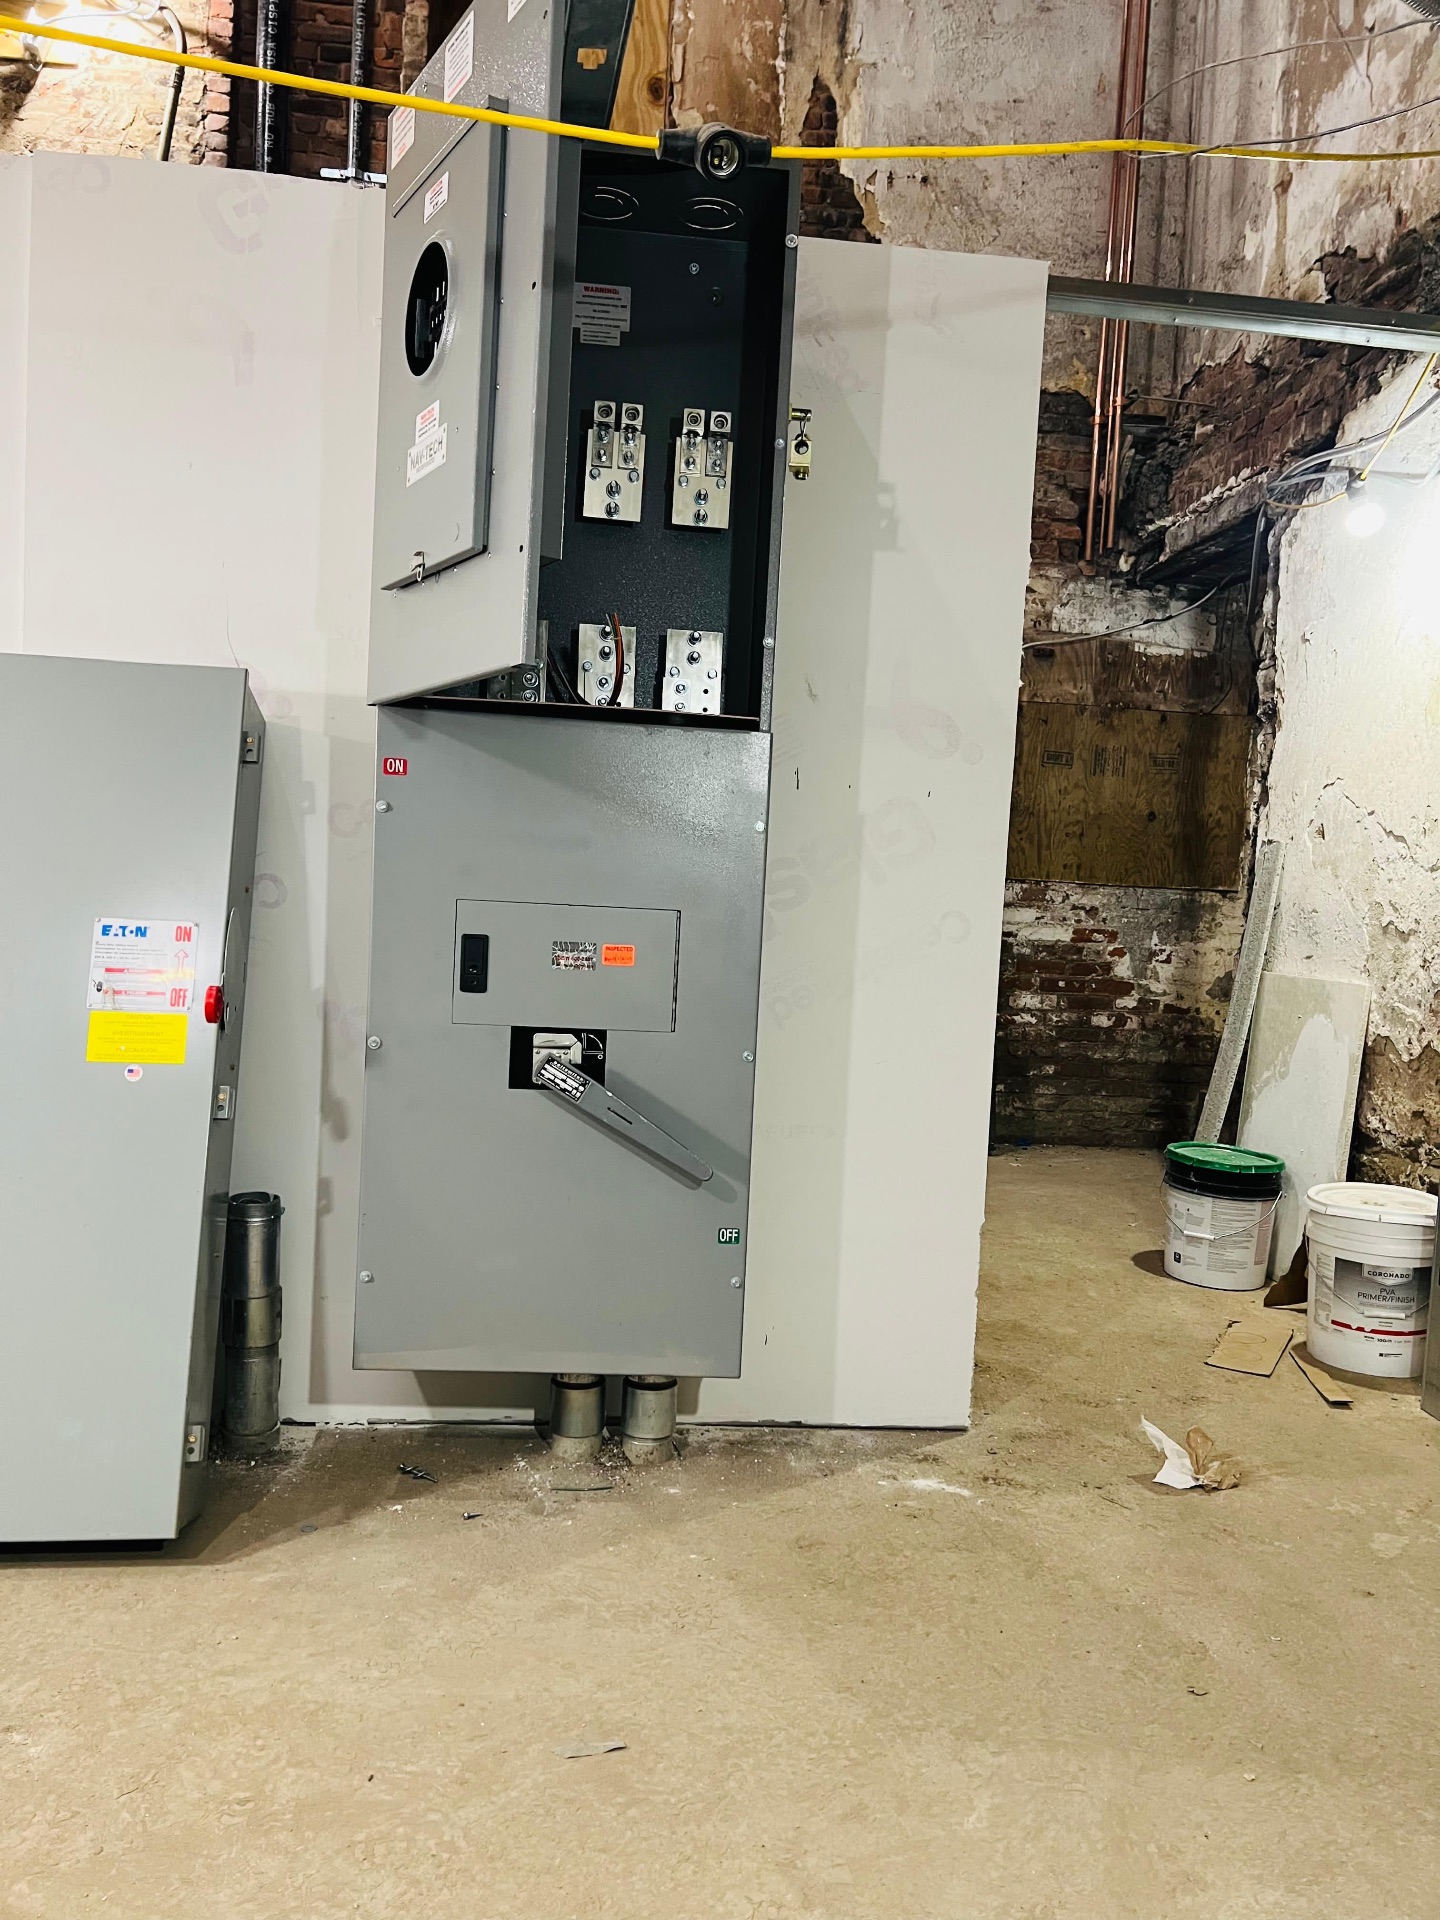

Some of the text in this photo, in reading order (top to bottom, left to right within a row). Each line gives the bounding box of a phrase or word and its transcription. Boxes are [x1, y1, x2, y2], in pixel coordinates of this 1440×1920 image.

[266, 42, 276, 65] USA
[266, 102, 275, 126] HUB
[386, 758, 404, 773] ON
[101, 924, 148, 938] EATON
[174, 925, 192, 942] ON
[169, 987, 188, 1008] OFF
[719, 1228, 739, 1242] OFF
[1367, 1270, 1410, 1279] CORONADO
[1357, 1291, 1415, 1303] PRIMER/FINISH
[1379, 1287, 1396, 1295] PVA
